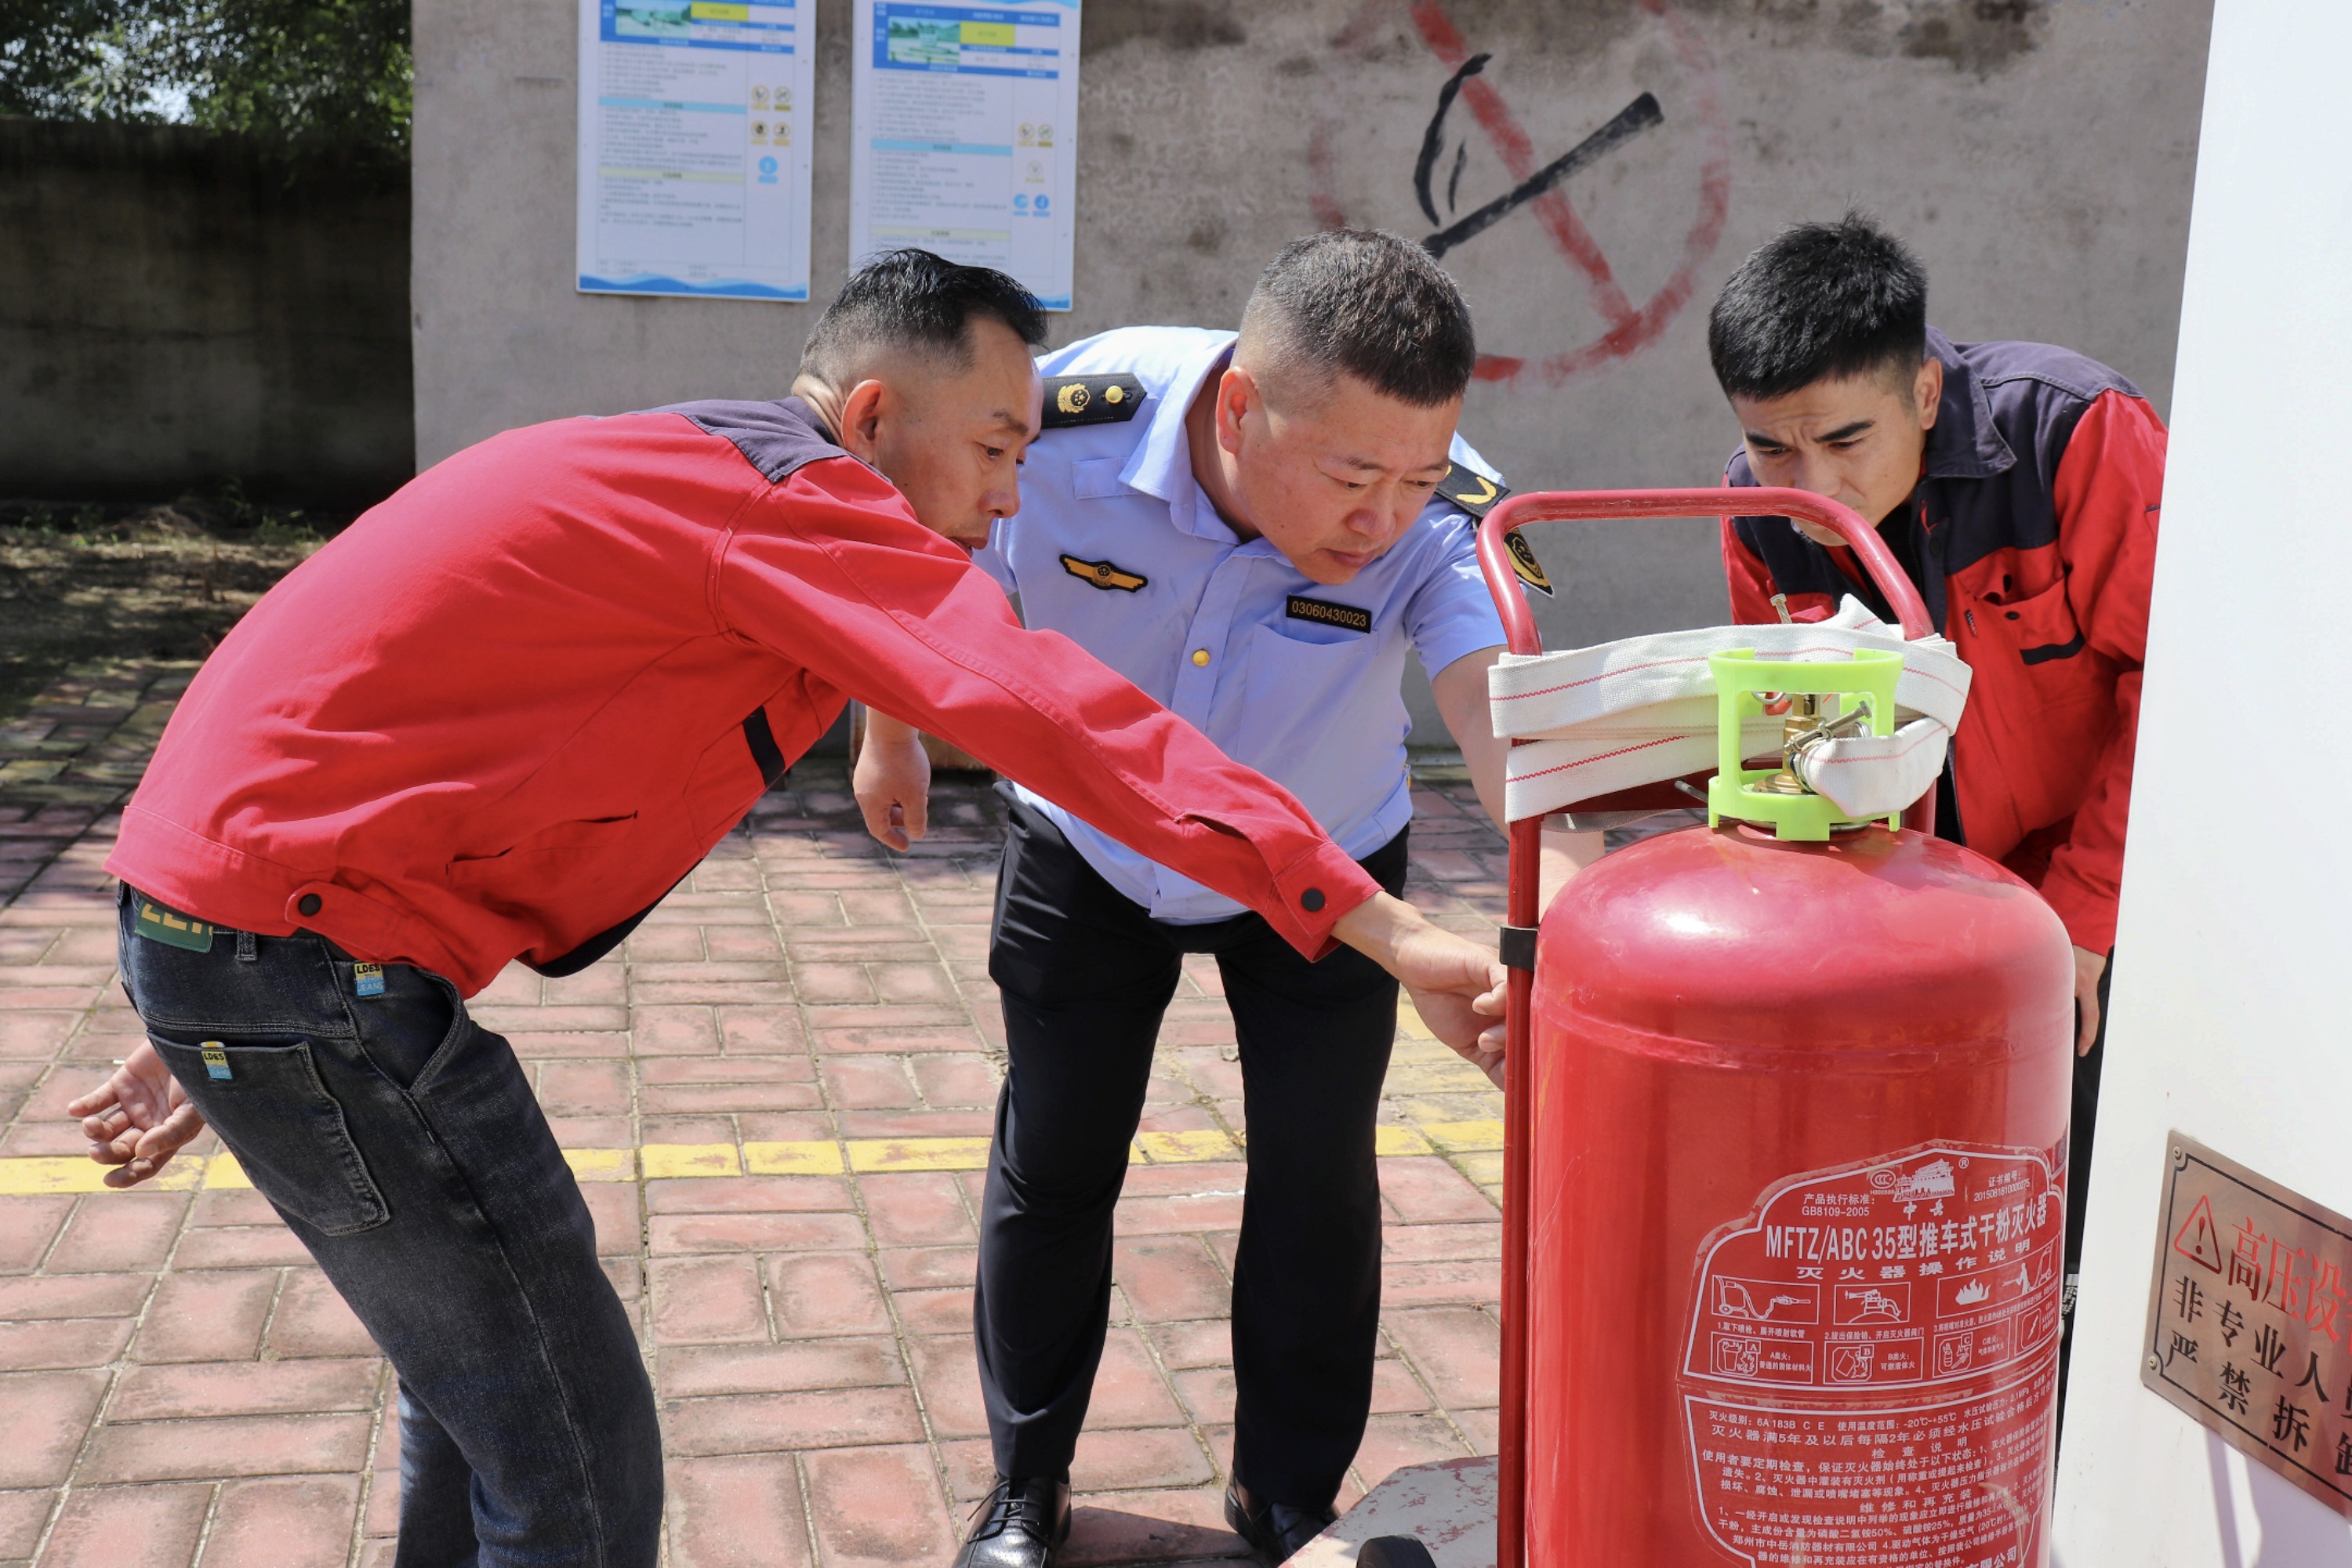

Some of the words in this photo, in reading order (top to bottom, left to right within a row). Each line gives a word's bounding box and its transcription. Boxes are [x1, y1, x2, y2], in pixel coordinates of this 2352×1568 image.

[1291, 601, 1367, 627] 03060430023
[203, 1052, 225, 1061] LDES
[1802, 1206, 1870, 1217] GB8109-2005
[1766, 1224, 1867, 1265] MFTZ/ABC
[1871, 1192, 2047, 1261] 35型推车式干粉灭火器
[2227, 1216, 2352, 1356] 高压设
